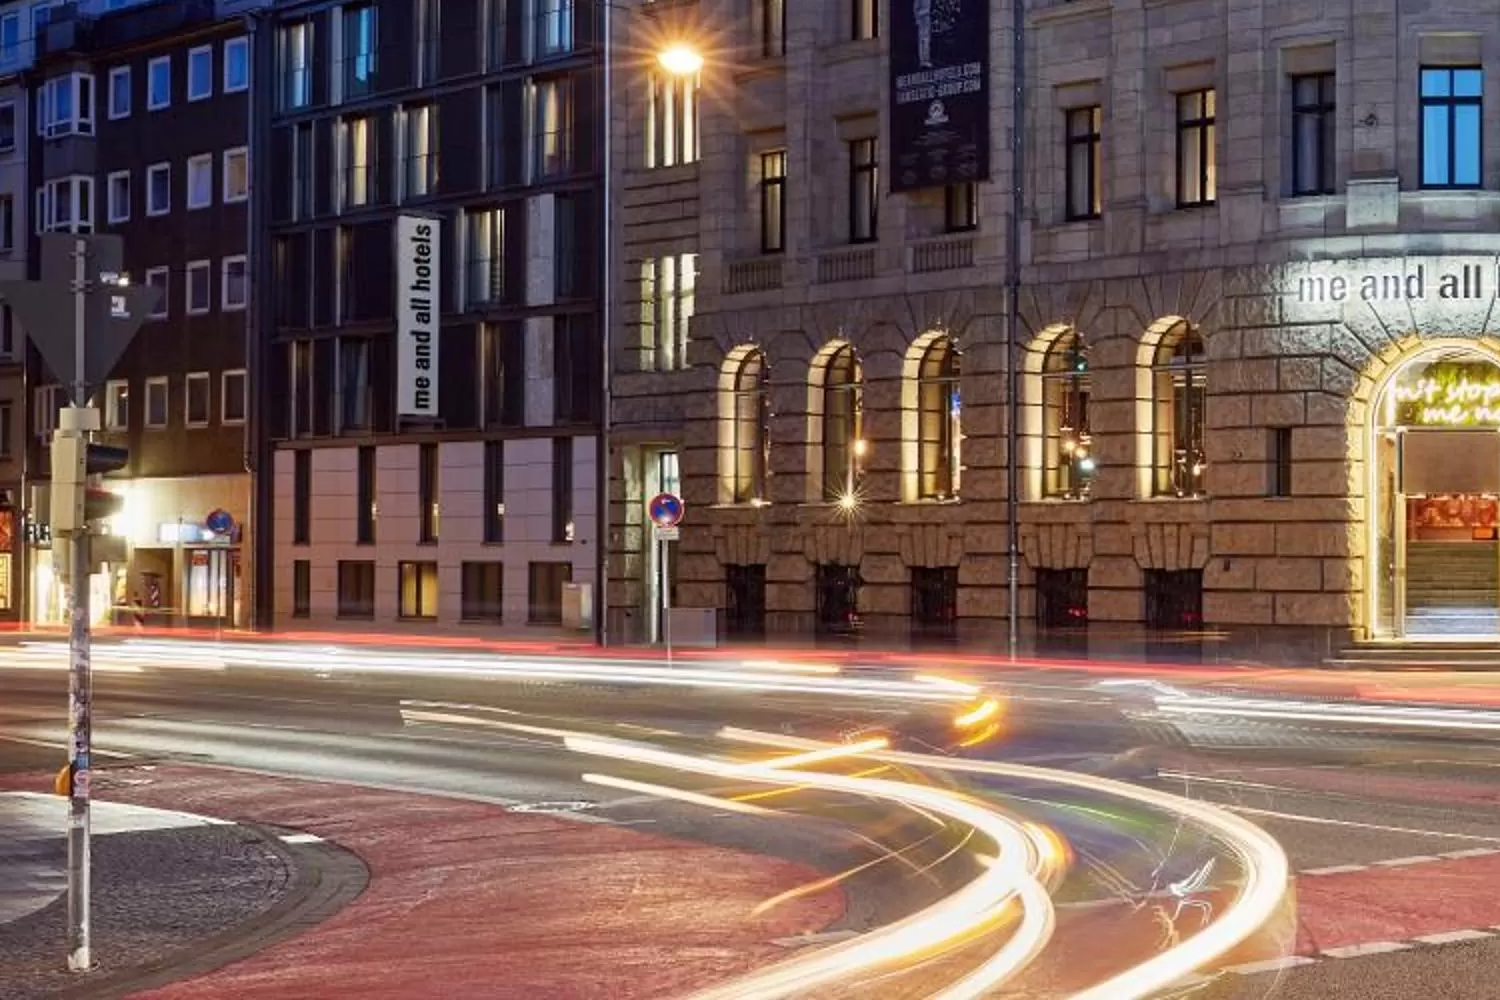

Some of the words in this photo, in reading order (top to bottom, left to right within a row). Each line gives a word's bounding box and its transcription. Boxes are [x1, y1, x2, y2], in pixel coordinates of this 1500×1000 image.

[410, 224, 432, 292] hotels
[1299, 275, 1347, 300] me
[1360, 264, 1425, 300] and
[1439, 264, 1481, 299] all
[410, 298, 431, 325] all
[410, 330, 431, 371] and
[414, 376, 431, 410] me
[1422, 403, 1469, 427] me
